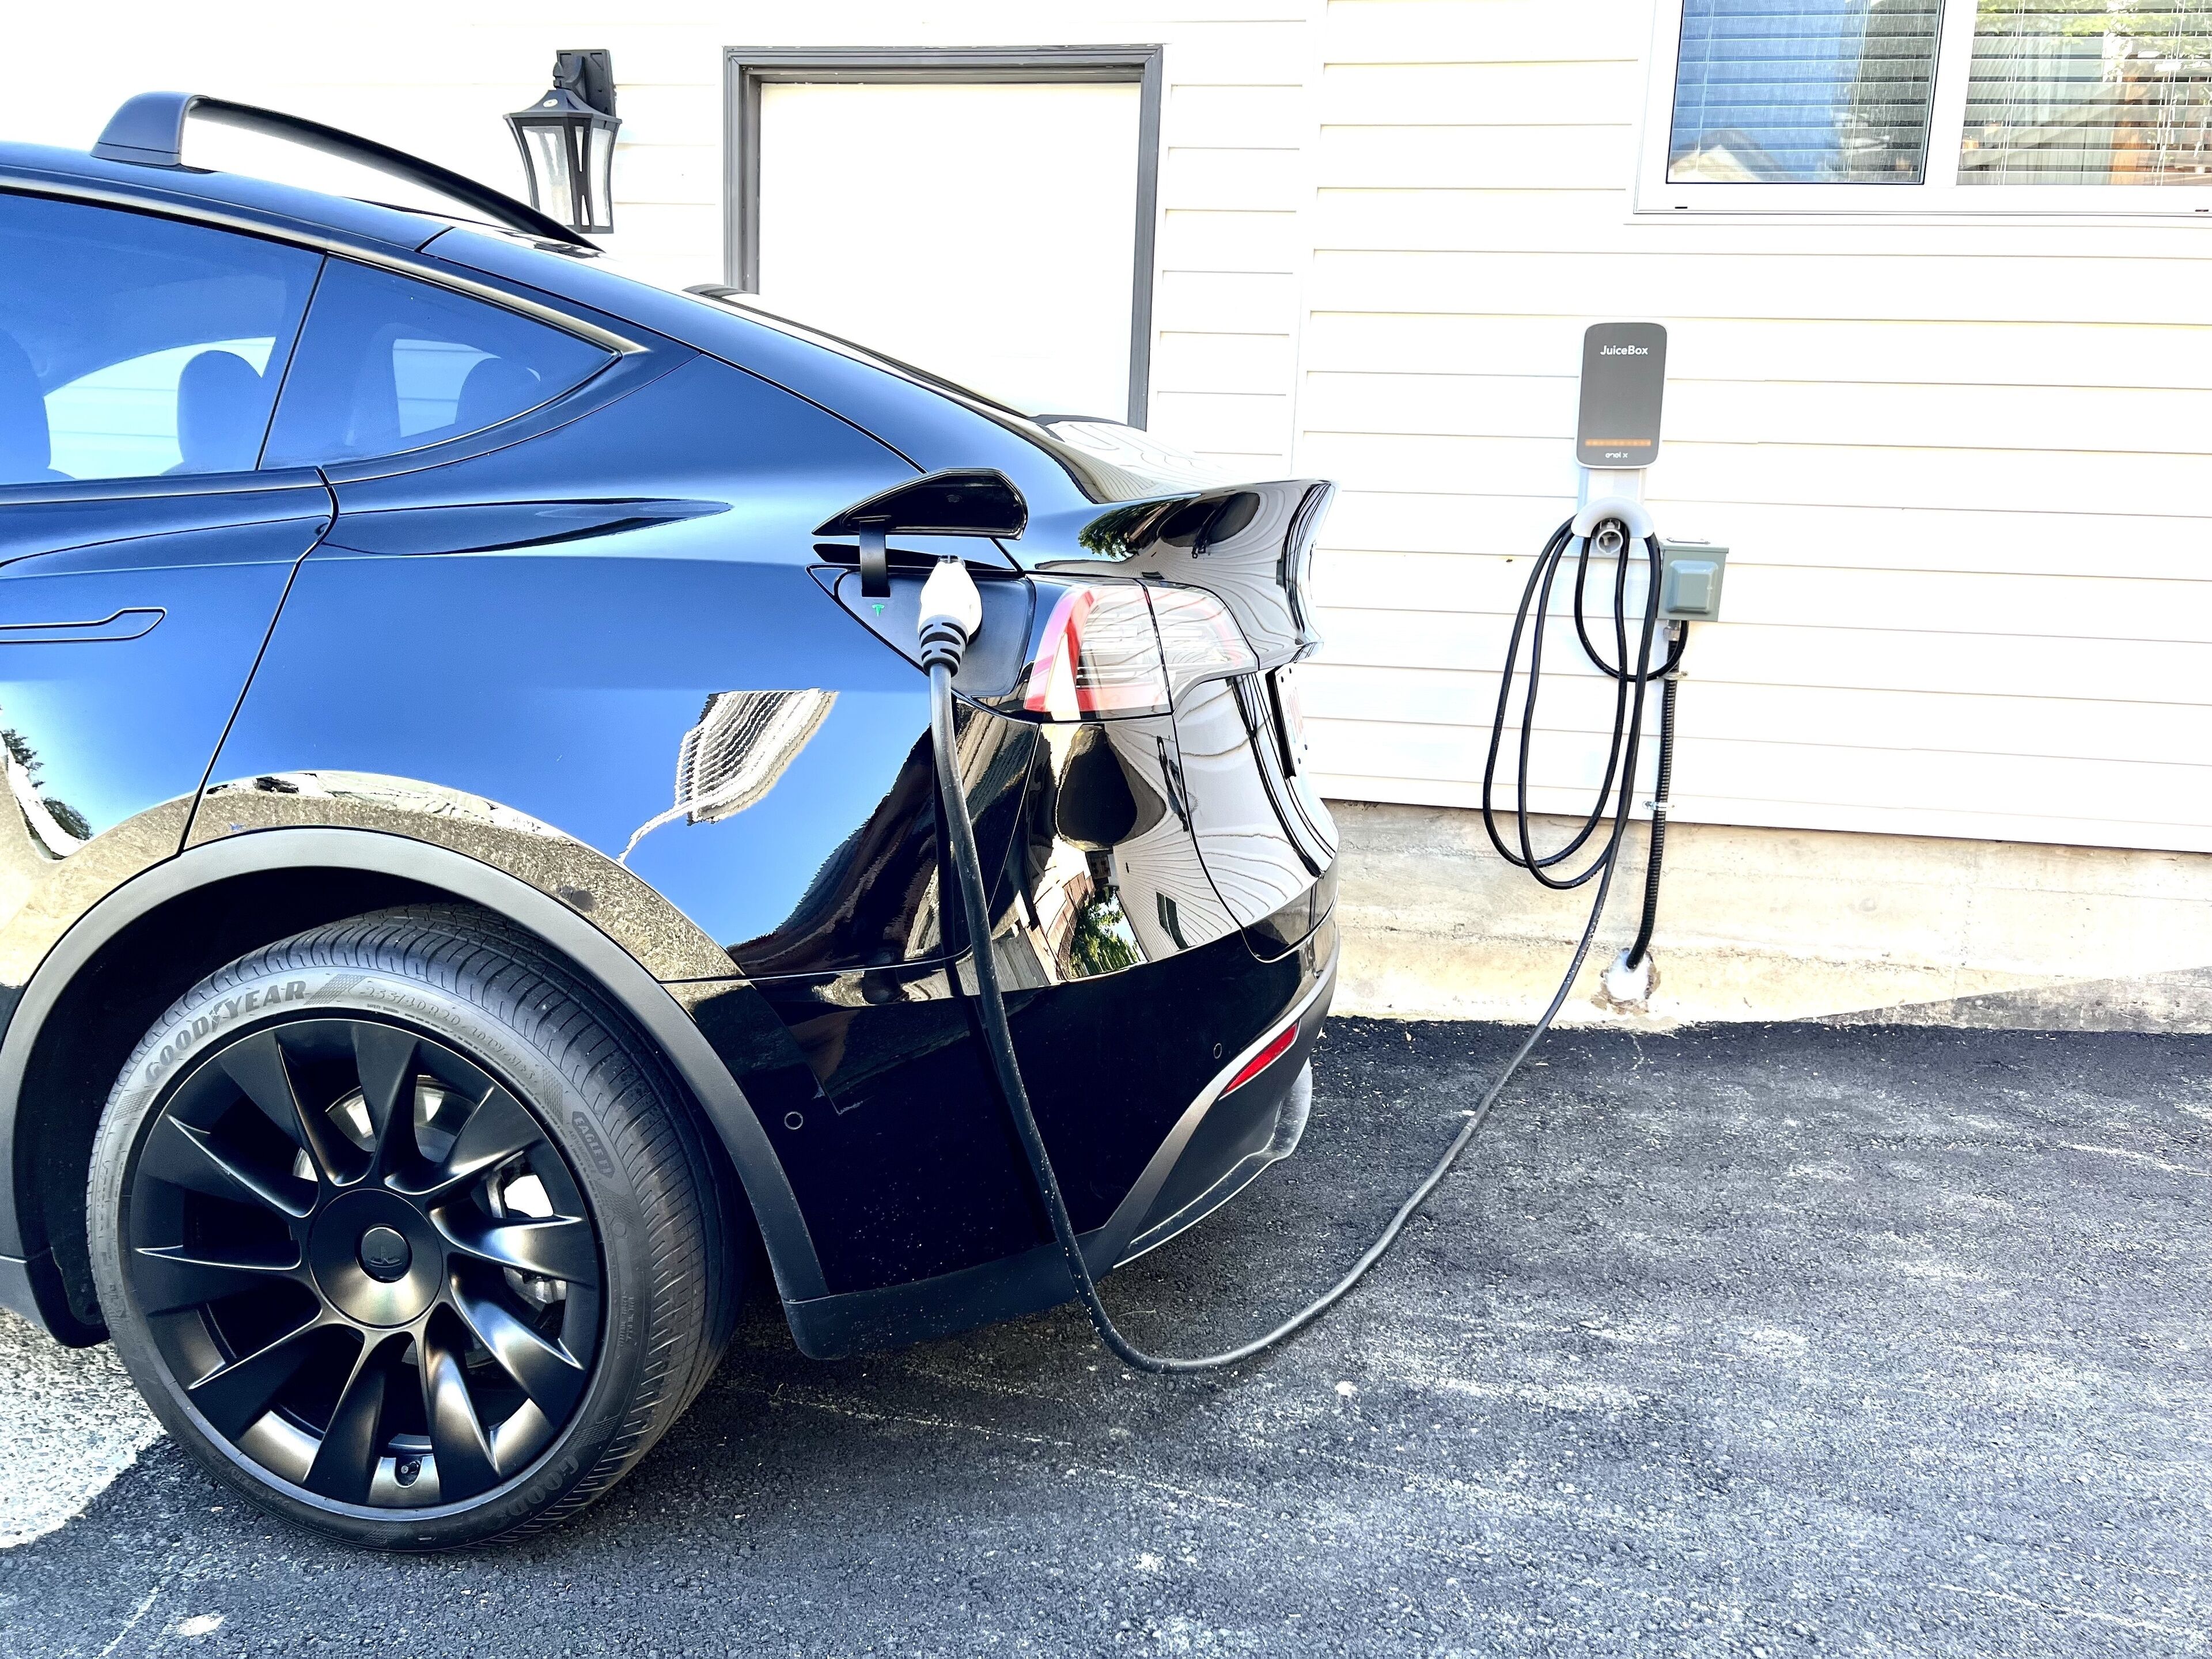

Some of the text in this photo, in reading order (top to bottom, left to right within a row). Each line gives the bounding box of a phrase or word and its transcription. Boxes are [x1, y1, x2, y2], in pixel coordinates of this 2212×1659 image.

[1600, 345, 1649, 355] JuiceBox
[145, 980, 307, 1083] GOODYEAR
[574, 1117, 604, 1157] EAGLE
